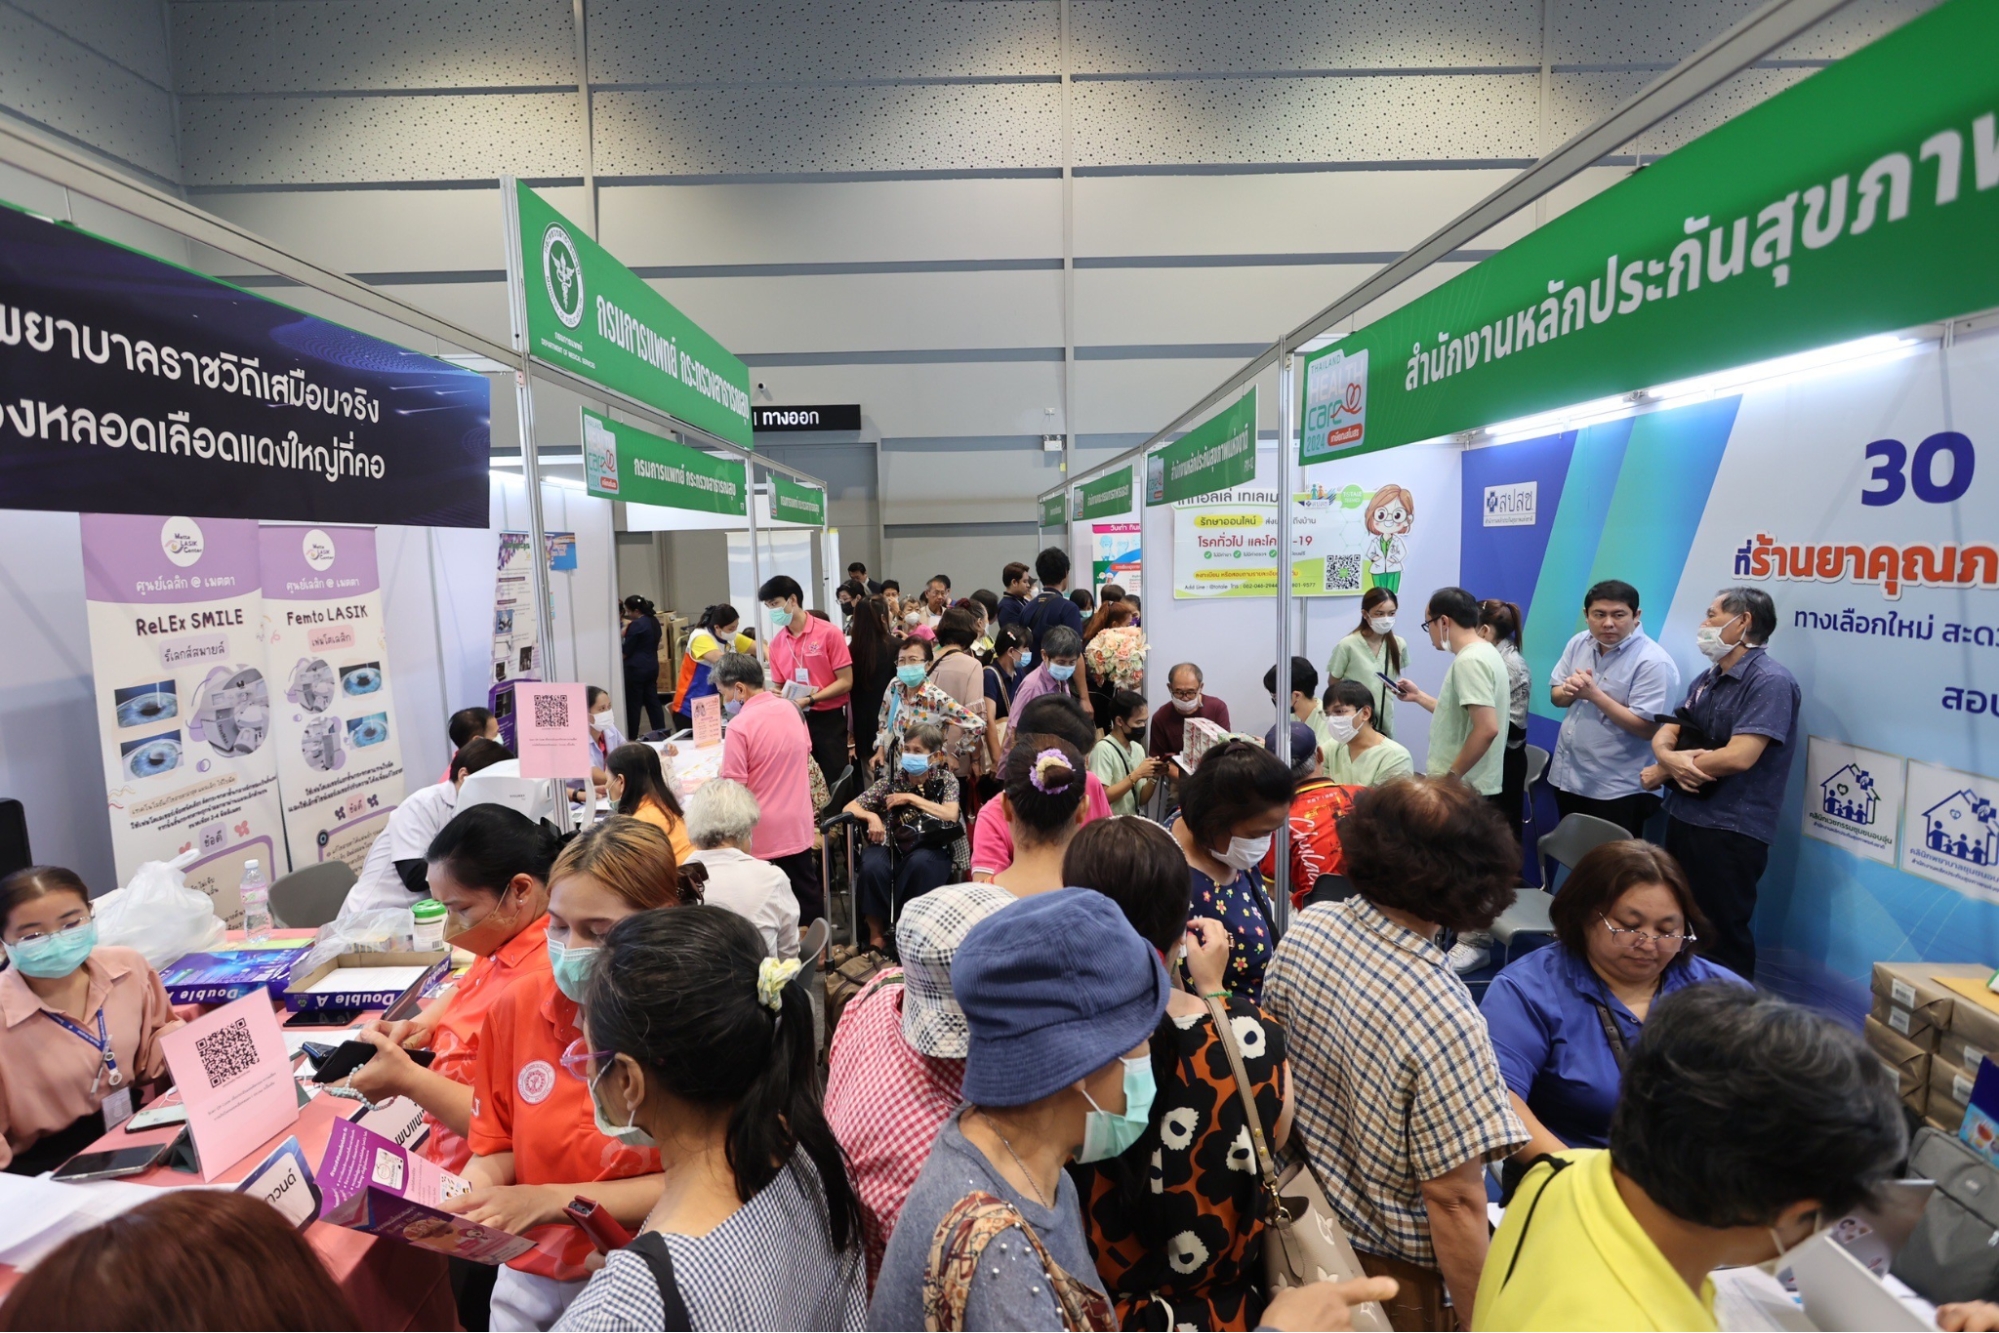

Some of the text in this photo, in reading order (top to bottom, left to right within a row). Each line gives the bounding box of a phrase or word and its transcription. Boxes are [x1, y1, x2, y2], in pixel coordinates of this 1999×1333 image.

[596, 294, 749, 425] กรมการแพทย์ กระทรวงสาธารณสุข
[1310, 355, 1341, 374] THAILAND
[1308, 360, 1364, 404] HEALTH
[763, 410, 819, 426] ทางออก
[0, 399, 386, 482] งหลอดเลือดแดงใหญ่ที่คอ
[1306, 433, 1326, 453] 2024
[633, 458, 685, 486] กรมการแพทย์
[1861, 431, 1976, 507] 30
[1200, 515, 1256, 526] รักษาออนไลน์
[1198, 532, 1244, 548] โรคทั่วไป
[136, 575, 236, 595] ศูนย์เลสิก @ เมตตา
[326, 578, 335, 588] @
[135, 608, 244, 637] ReLEx SMILE
[286, 604, 369, 626] Femto LASIK
[1794, 607, 1999, 648] ทางเลือกใหม่ สะด
[204, 829, 224, 848] ข้อดี
[179, 987, 240, 1000] Double
[315, 991, 396, 1007] A Double
